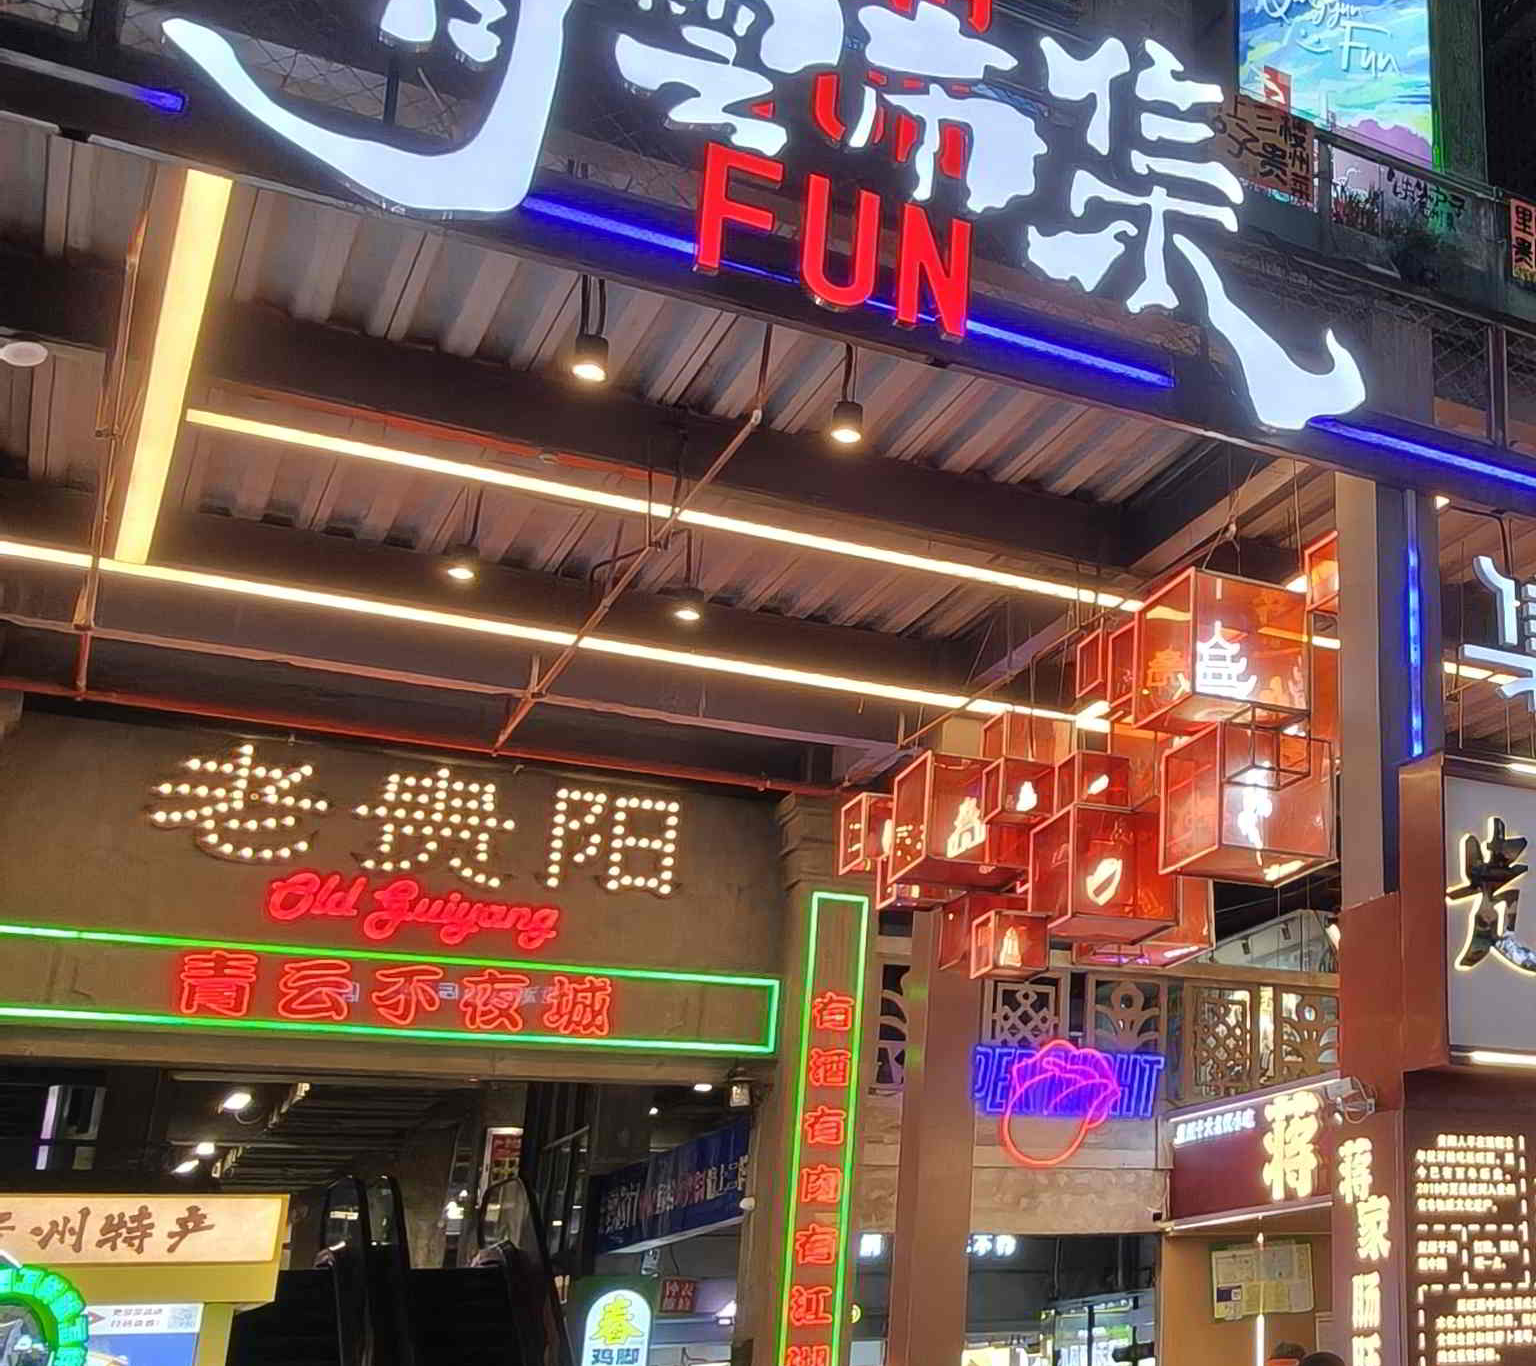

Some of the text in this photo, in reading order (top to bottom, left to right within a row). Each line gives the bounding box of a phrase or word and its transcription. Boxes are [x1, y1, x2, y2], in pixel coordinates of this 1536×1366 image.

[1338, 19, 1403, 76] Fun
[693, 140, 973, 342] FUN
[151, 743, 682, 896] 老贵阳
[266, 872, 561, 950] Old Guiyang
[177, 949, 612, 1038] 青云不夜城
[0, 1202, 216, 1256] 州特产
[591, 1347, 640, 1366] 鸡脚
